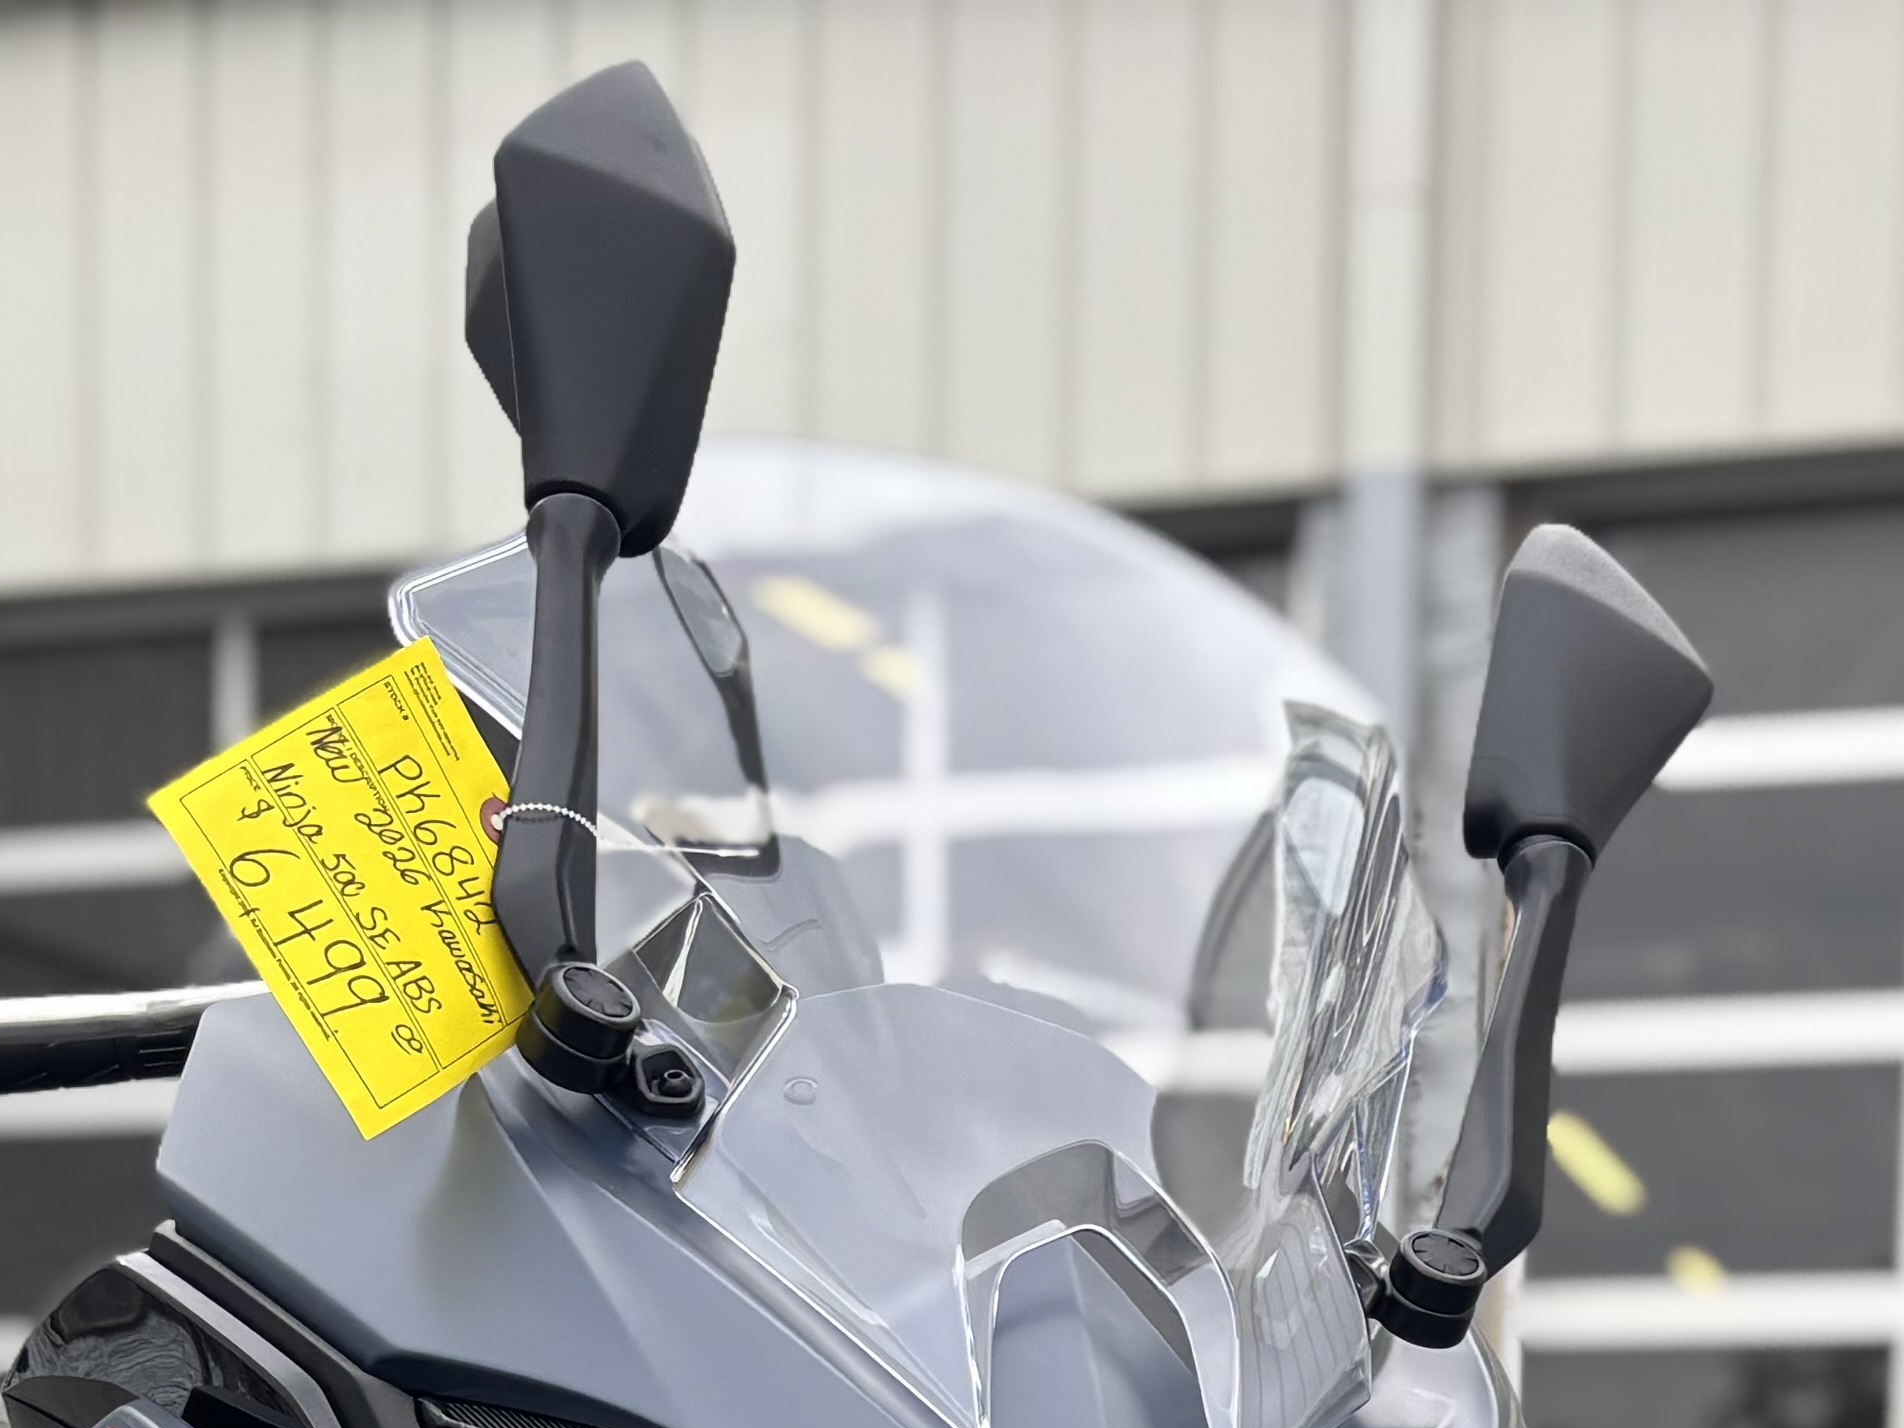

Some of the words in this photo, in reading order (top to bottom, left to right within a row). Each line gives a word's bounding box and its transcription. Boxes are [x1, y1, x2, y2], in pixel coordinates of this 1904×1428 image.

[262, 763, 324, 844] Ninja
[356, 906, 401, 950] SE
[386, 960, 442, 1015] ABS
[306, 725, 368, 783] New
[354, 808, 432, 886] 2026
[377, 755, 496, 935] PK6842
